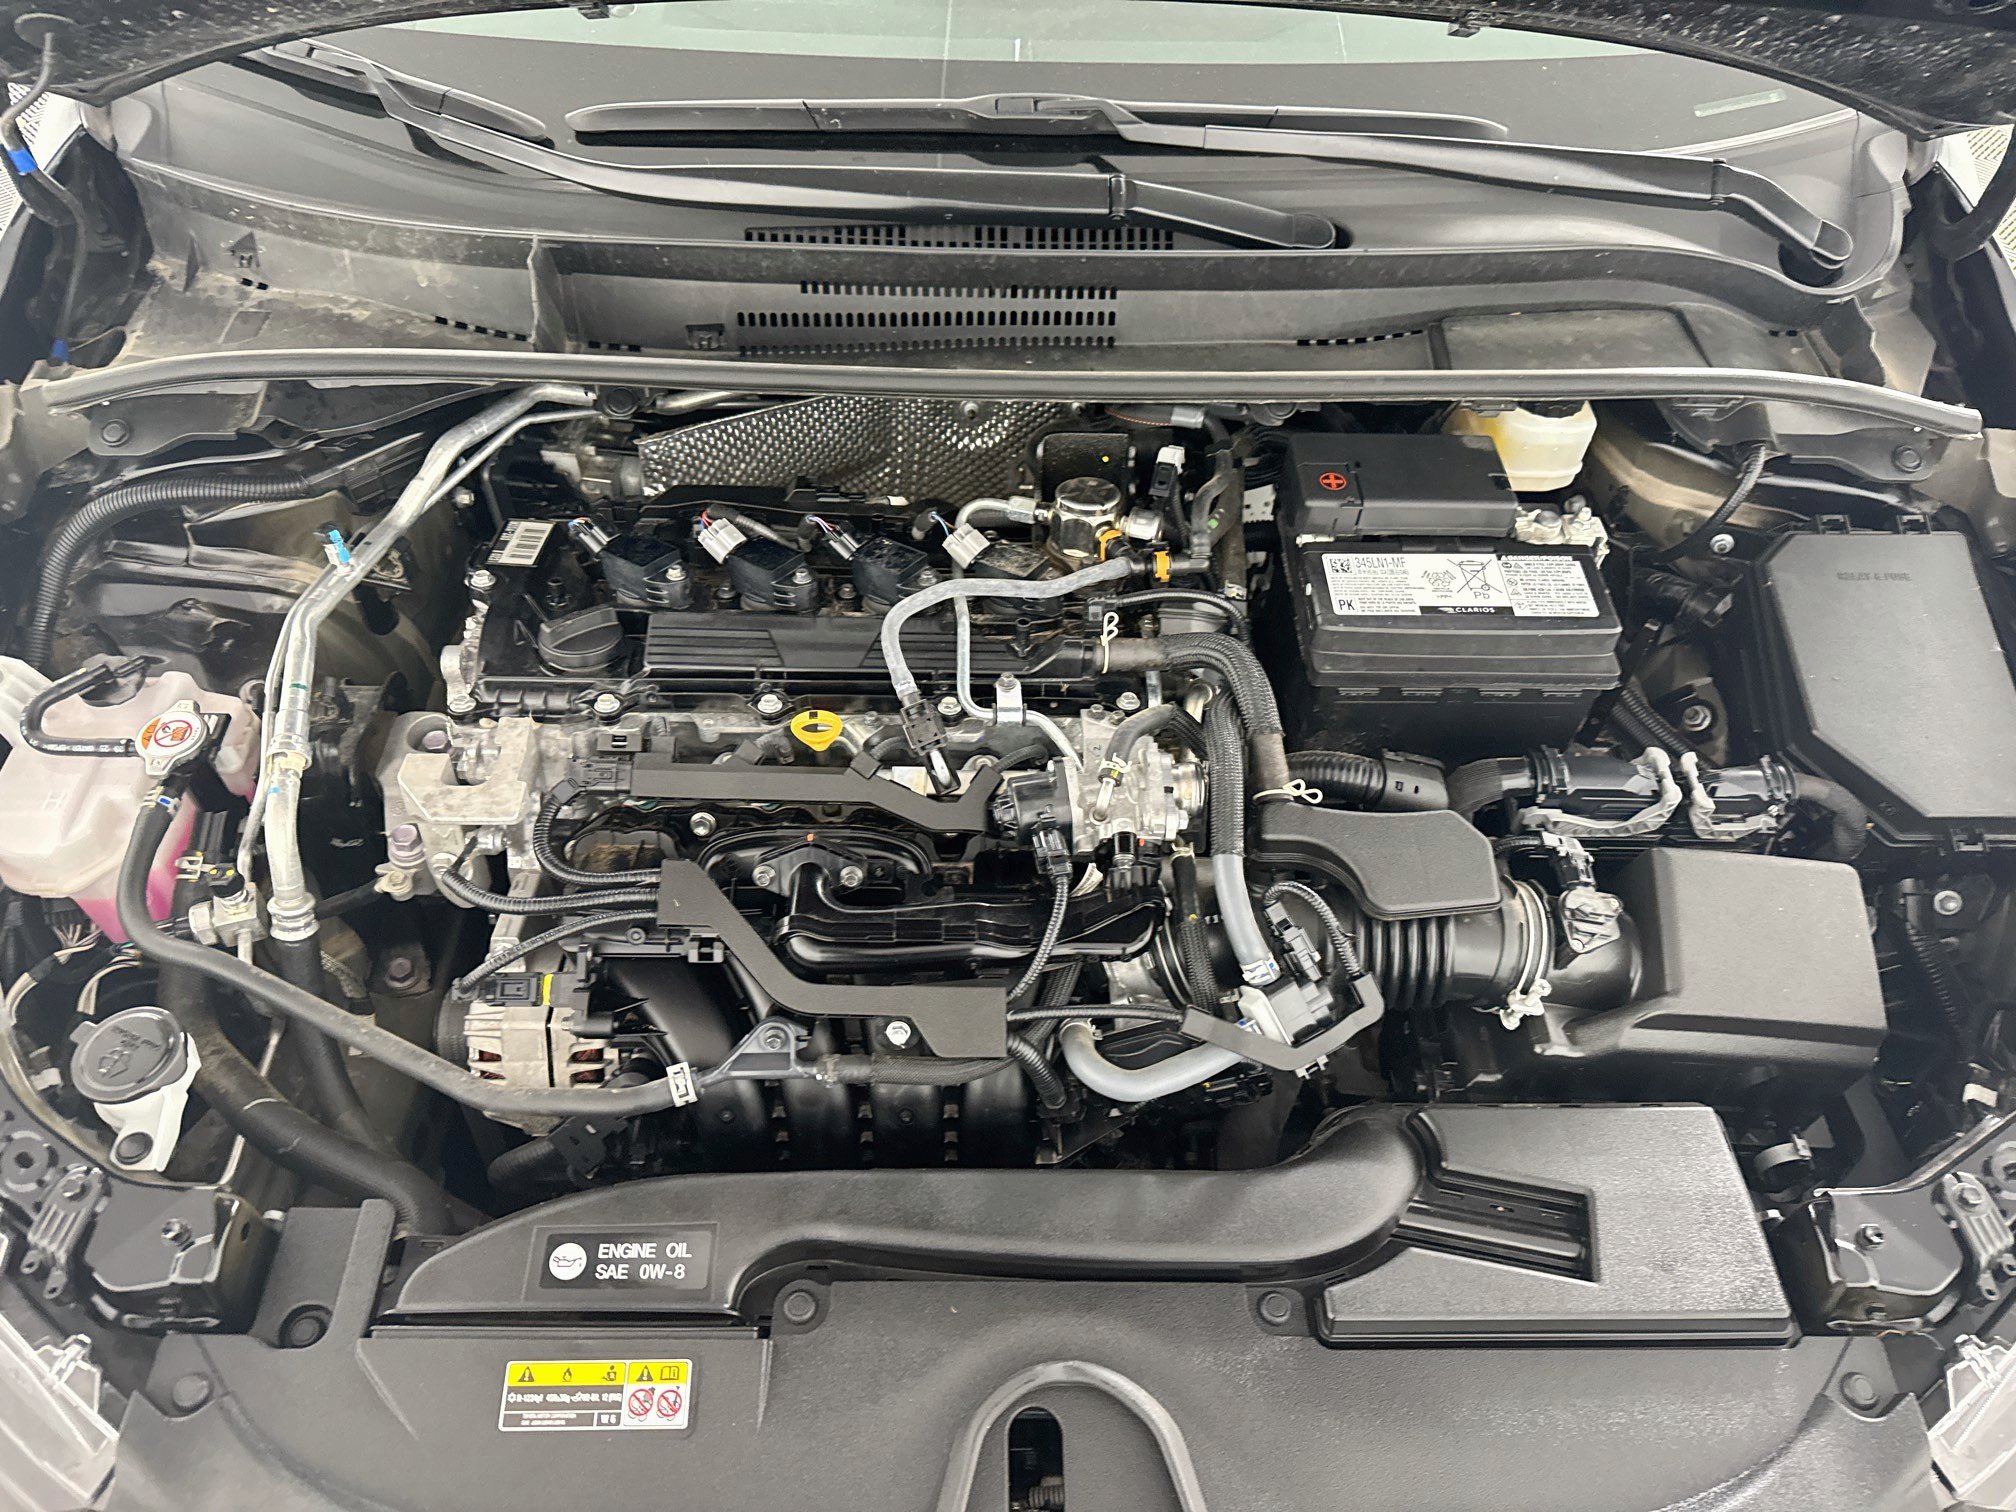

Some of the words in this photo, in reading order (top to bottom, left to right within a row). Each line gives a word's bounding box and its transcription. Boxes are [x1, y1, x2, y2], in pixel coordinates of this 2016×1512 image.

[1354, 557, 1406, 568] 345LN1-MF
[1473, 591, 1490, 600] Pb
[1338, 599, 1356, 611] PK
[597, 1243, 657, 1259] ENGINE
[665, 1242, 692, 1258] OIL
[595, 1264, 629, 1280] SAE
[639, 1264, 686, 1280] 0W-8
